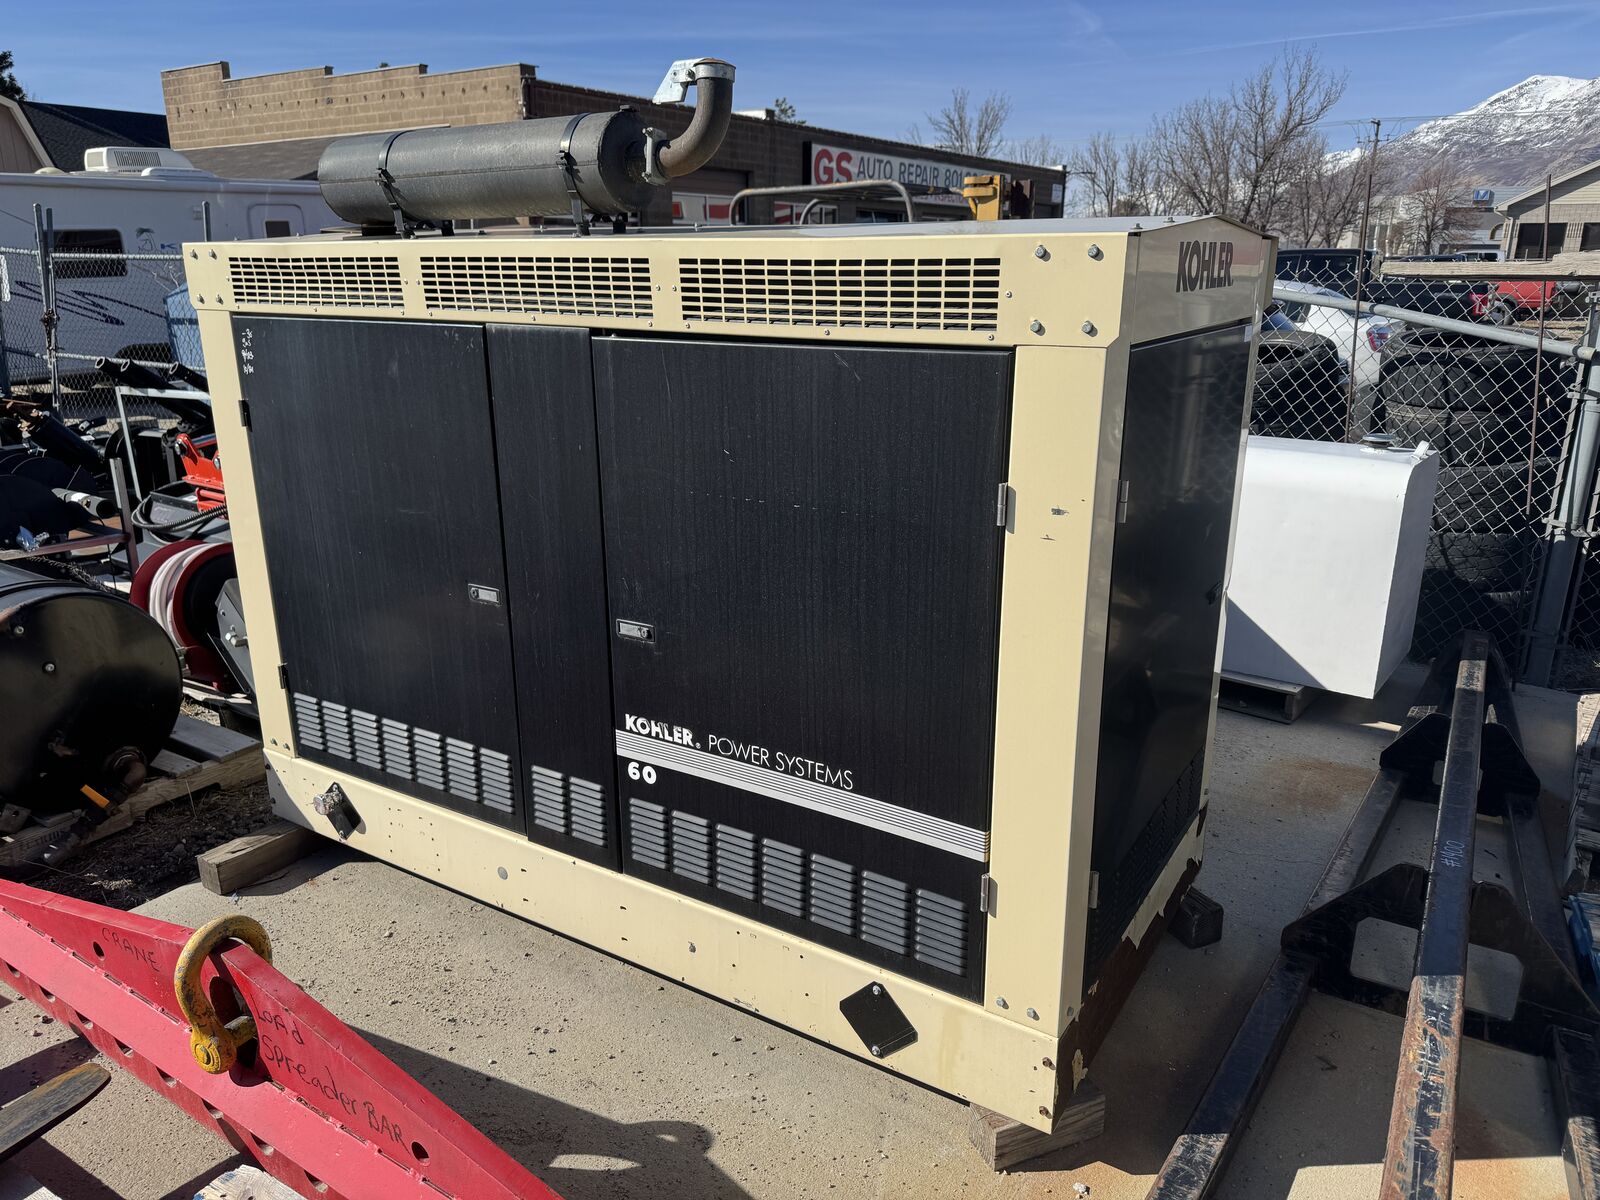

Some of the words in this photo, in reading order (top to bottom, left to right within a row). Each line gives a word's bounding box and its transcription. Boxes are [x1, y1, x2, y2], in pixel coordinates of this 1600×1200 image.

[814, 148, 853, 185] GS
[857, 156, 893, 179] AUTO
[899, 161, 940, 188] REPAIR
[1176, 240, 1234, 293] KOHLER
[625, 713, 695, 747] KOHLER
[708, 734, 771, 767] POWER
[775, 751, 854, 790] SYSTEMS
[627, 761, 657, 785] 60
[102, 927, 160, 972] CRANE
